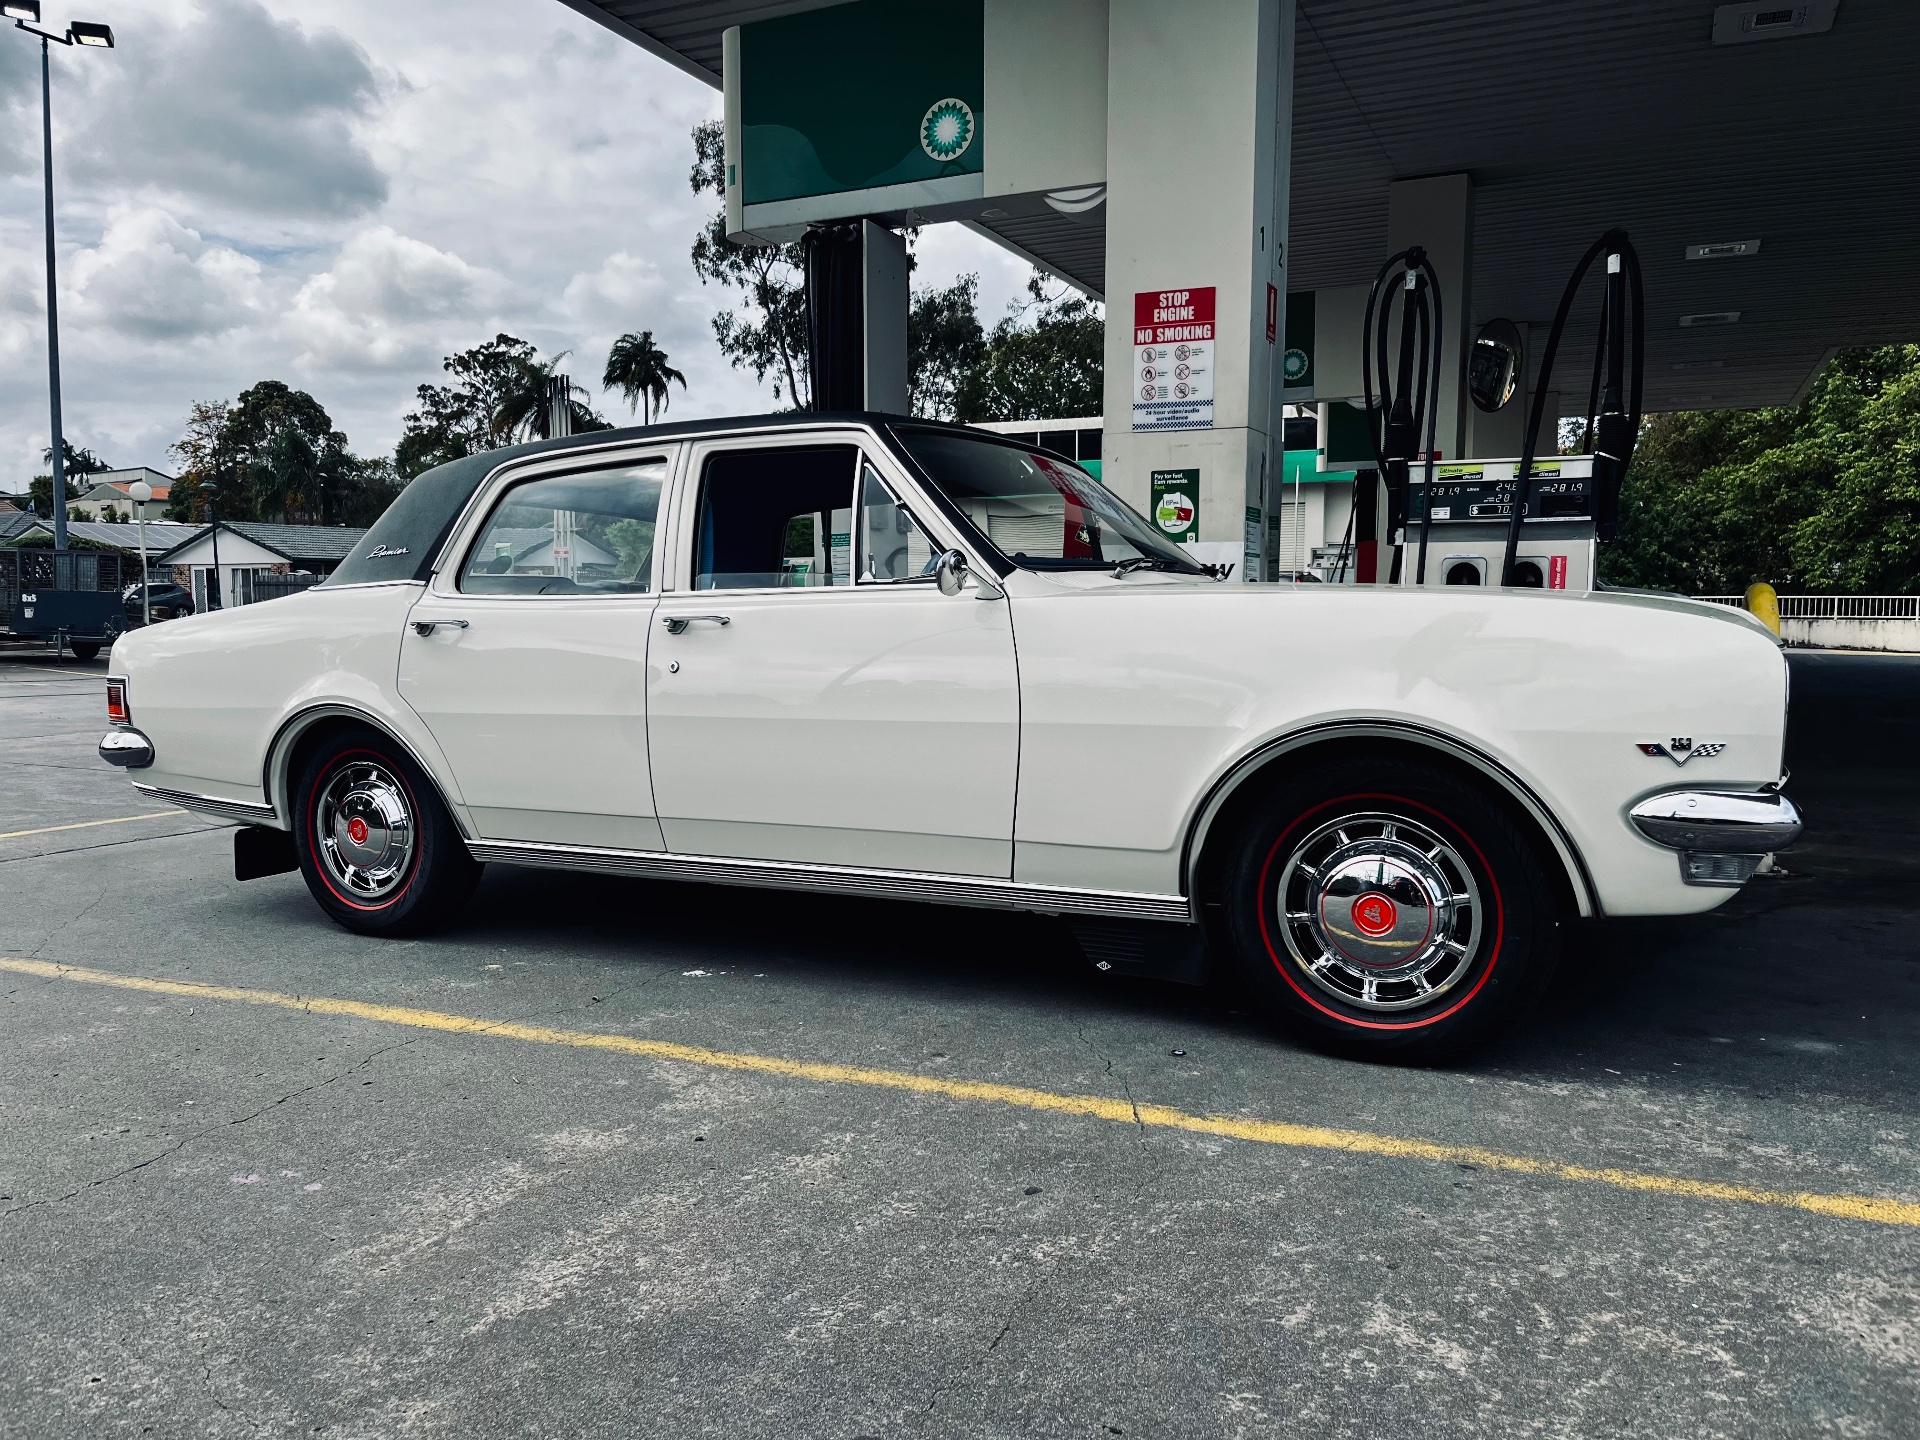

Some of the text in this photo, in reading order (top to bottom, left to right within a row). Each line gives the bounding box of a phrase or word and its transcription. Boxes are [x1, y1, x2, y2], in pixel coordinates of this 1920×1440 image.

[1260, 226, 1265, 252] 1
[1278, 242, 1283, 269] 2
[1159, 291, 1189, 307] STOP
[1153, 306, 1195, 322] ENGINE
[1136, 324, 1212, 343] NO SMOKING
[1167, 407, 1200, 415] video/audio
[1430, 487, 1460, 496] 281.9
[1551, 482, 1583, 493] 281.9
[1471, 506, 1479, 515] $
[366, 544, 410, 559] Premier
[21, 593, 37, 602] 8x5
